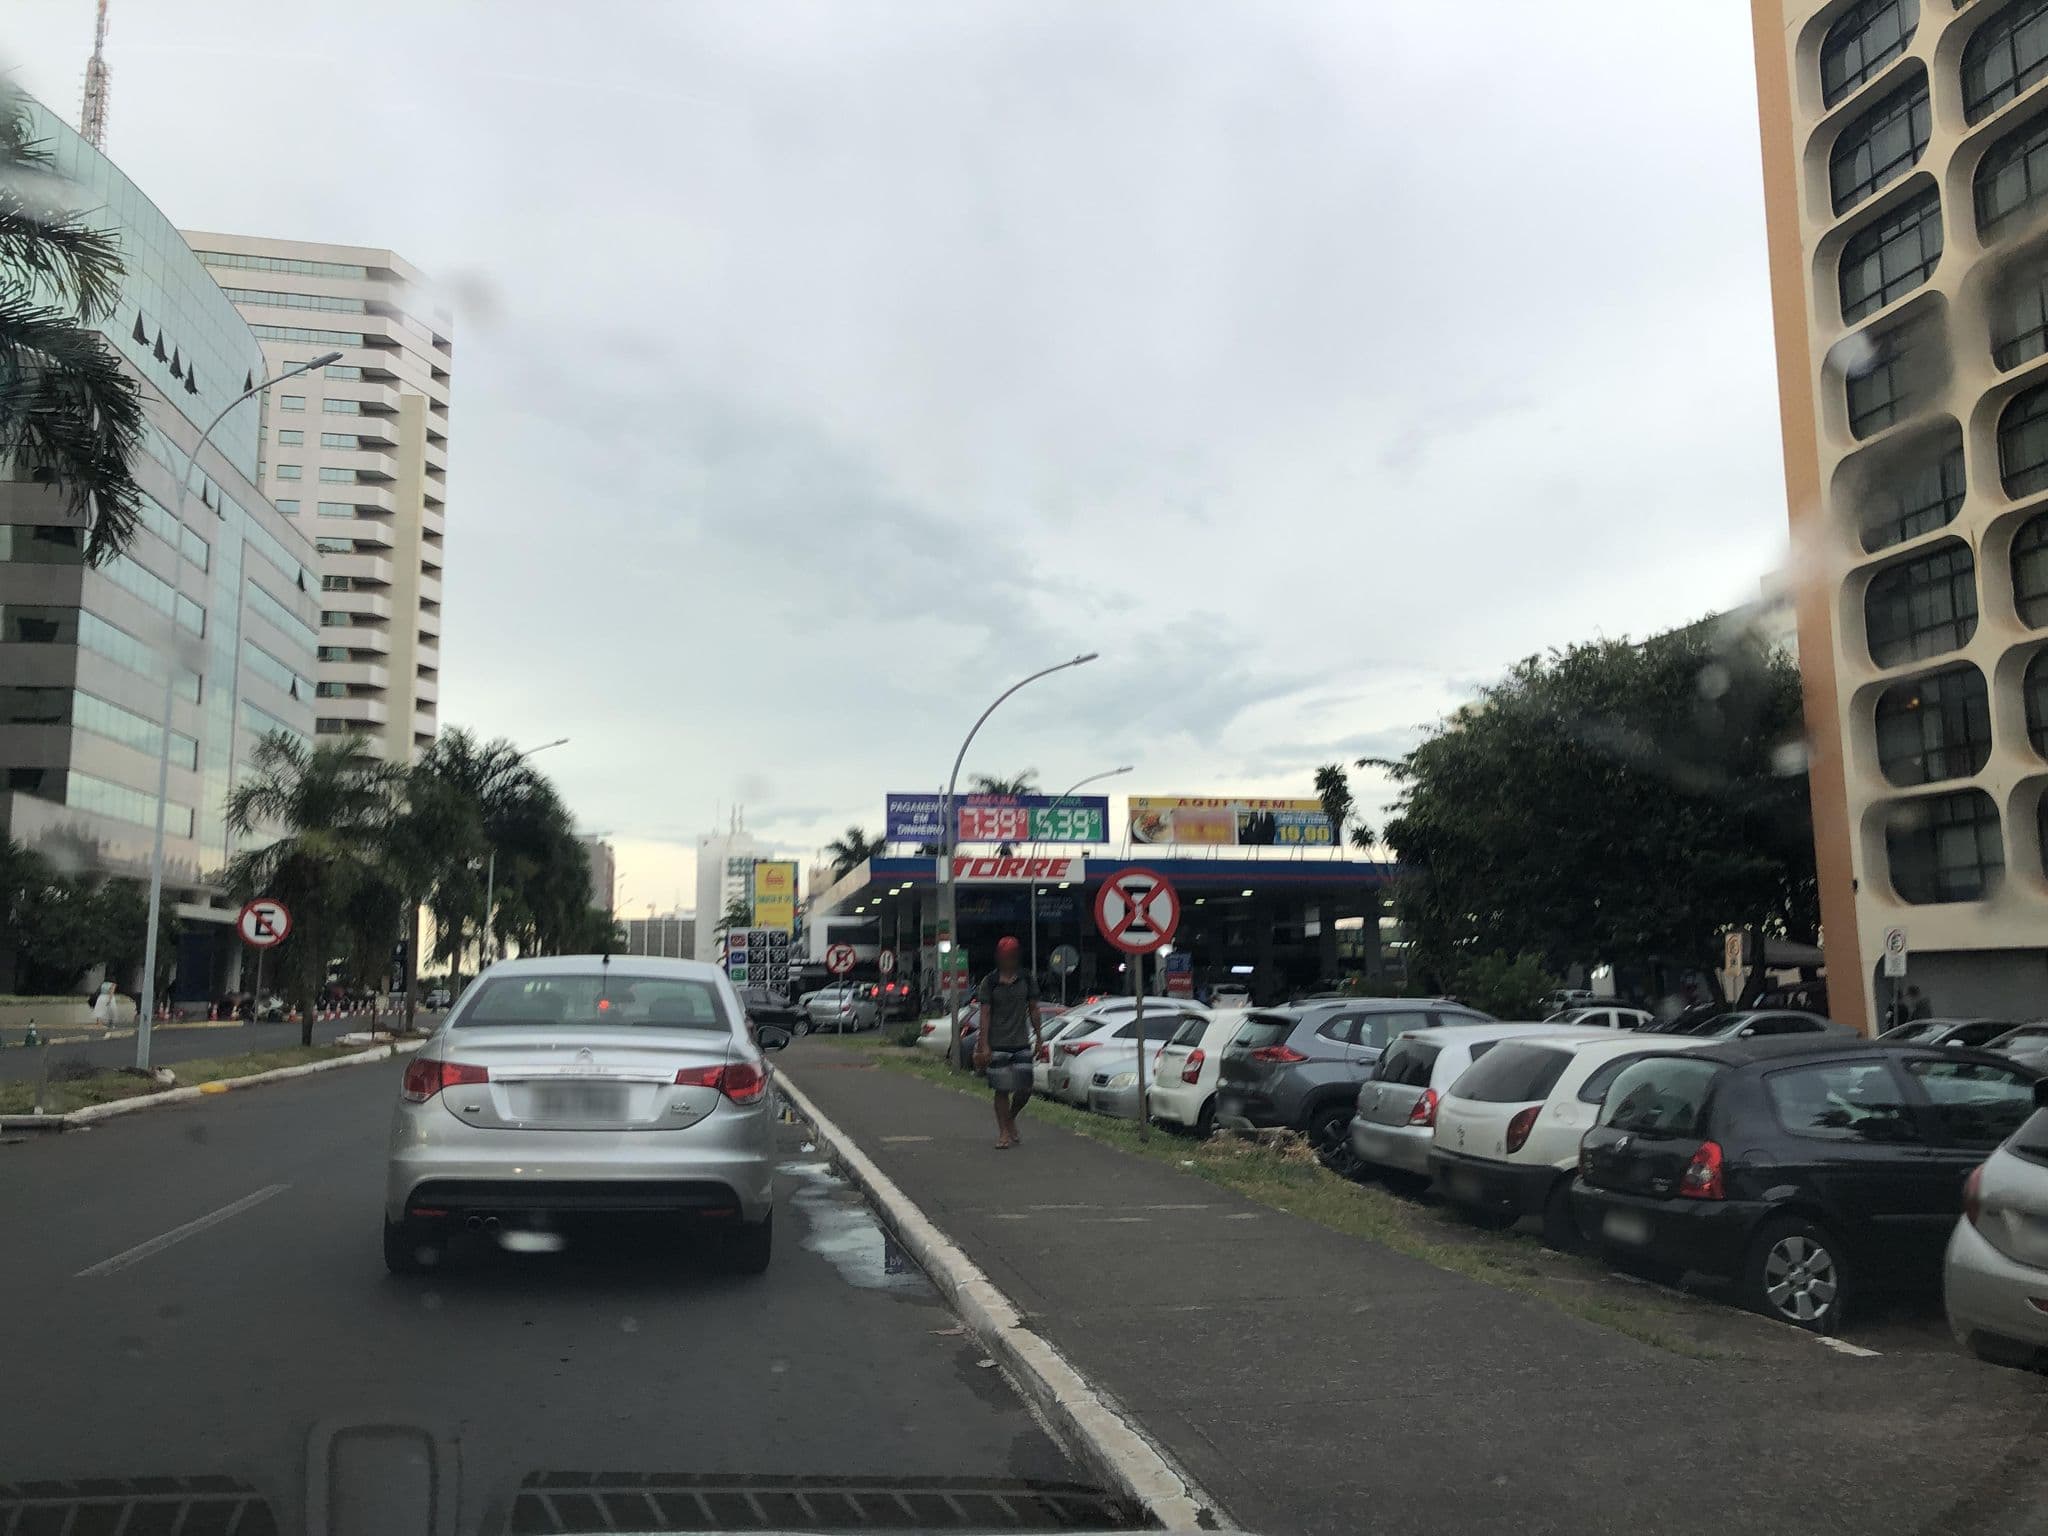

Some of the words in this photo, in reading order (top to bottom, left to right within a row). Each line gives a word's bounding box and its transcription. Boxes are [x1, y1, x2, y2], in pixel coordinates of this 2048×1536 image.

[913, 813, 929, 824] EM
[953, 858, 1070, 877] TORRE
[255, 910, 275, 935] E
